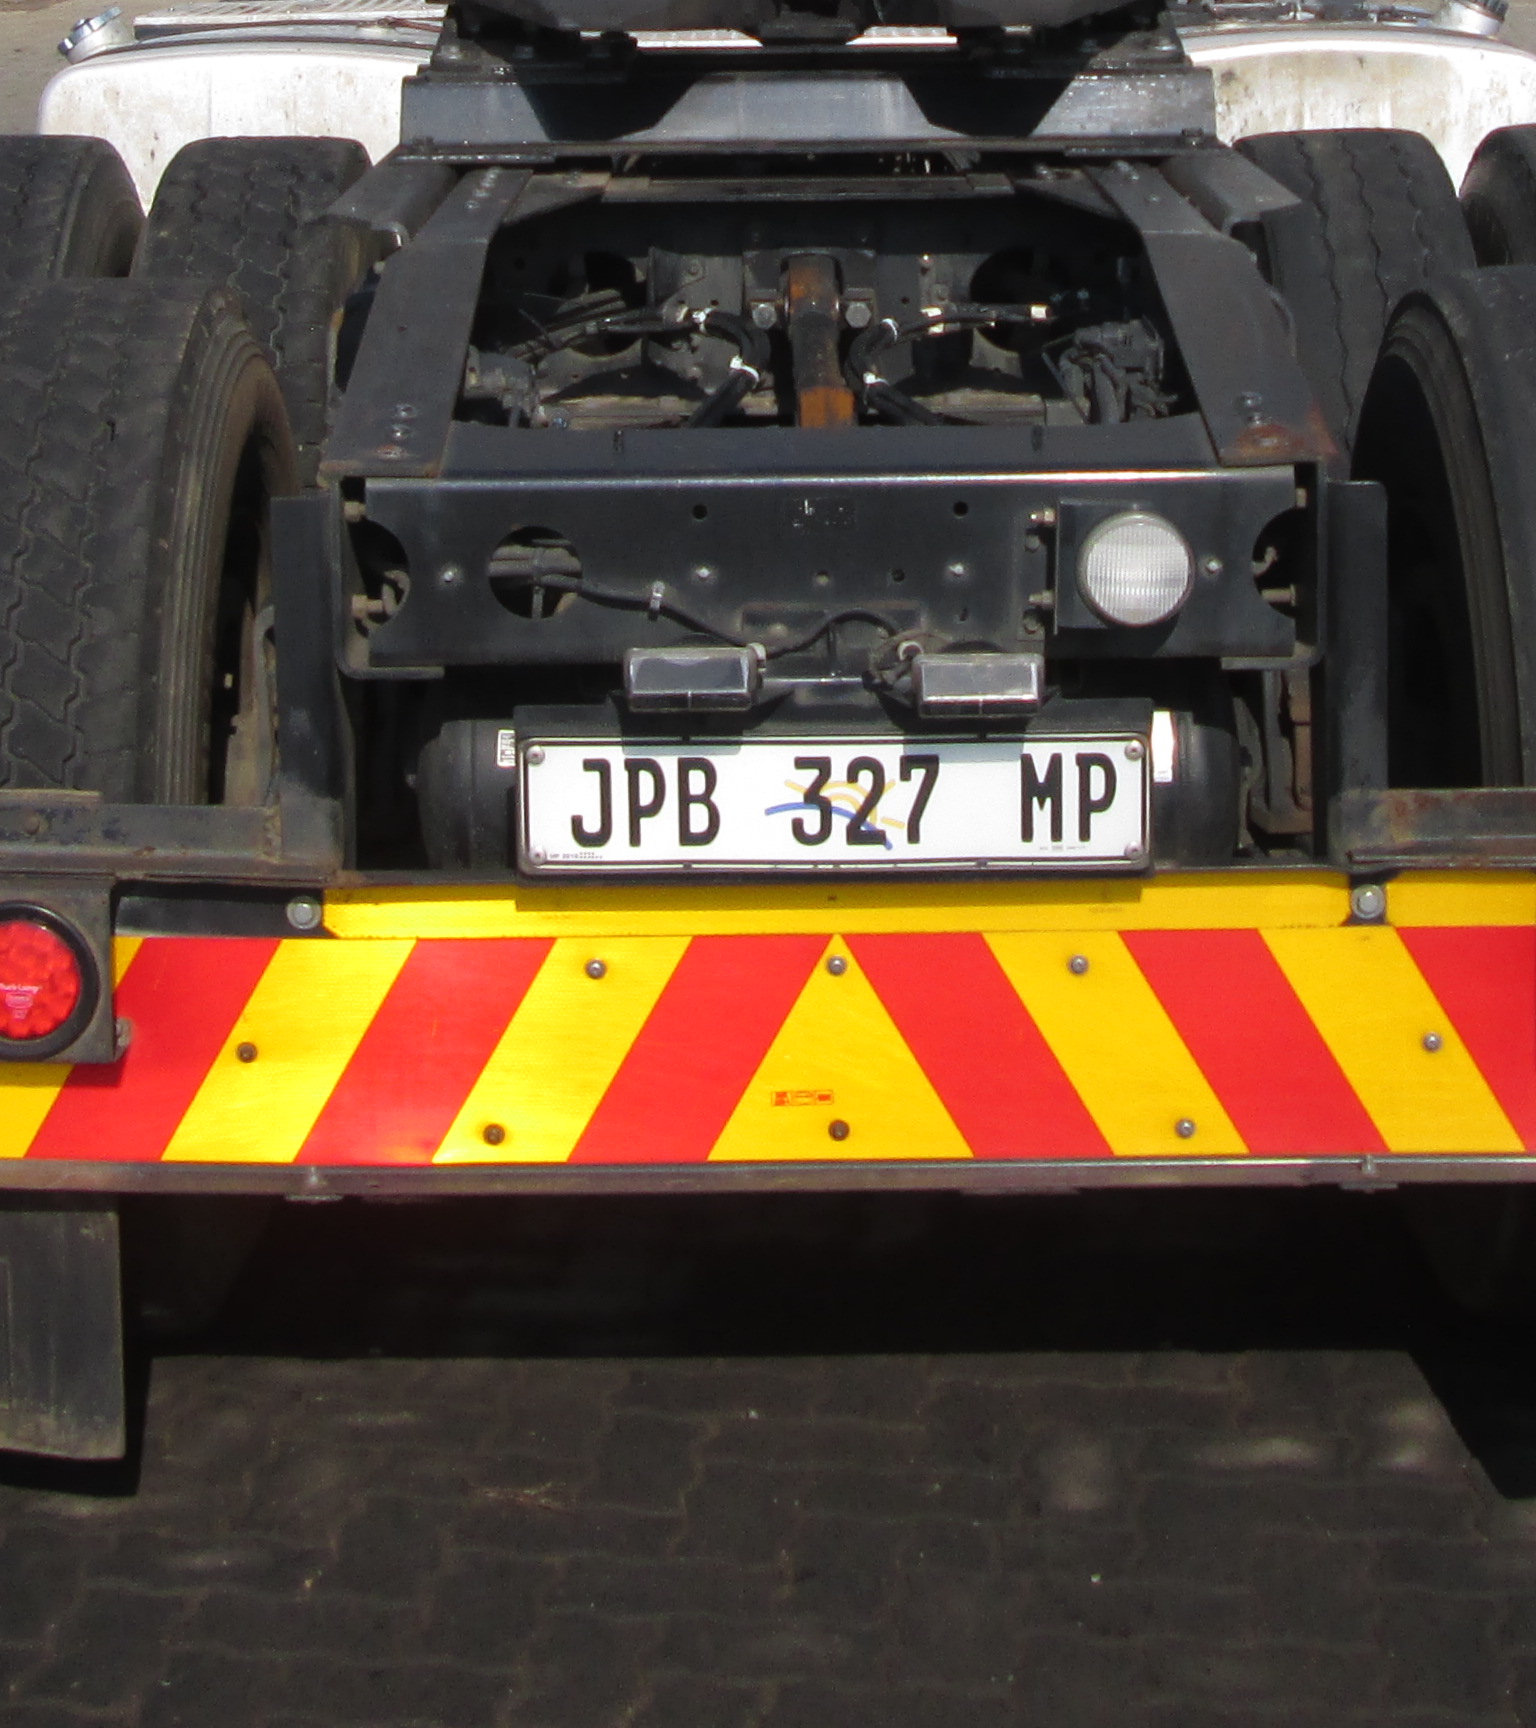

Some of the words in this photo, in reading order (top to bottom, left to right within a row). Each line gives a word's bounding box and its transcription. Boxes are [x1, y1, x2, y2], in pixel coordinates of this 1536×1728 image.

[570, 756, 721, 848] JPB
[791, 753, 941, 847] 327
[1019, 752, 1118, 843] MP
